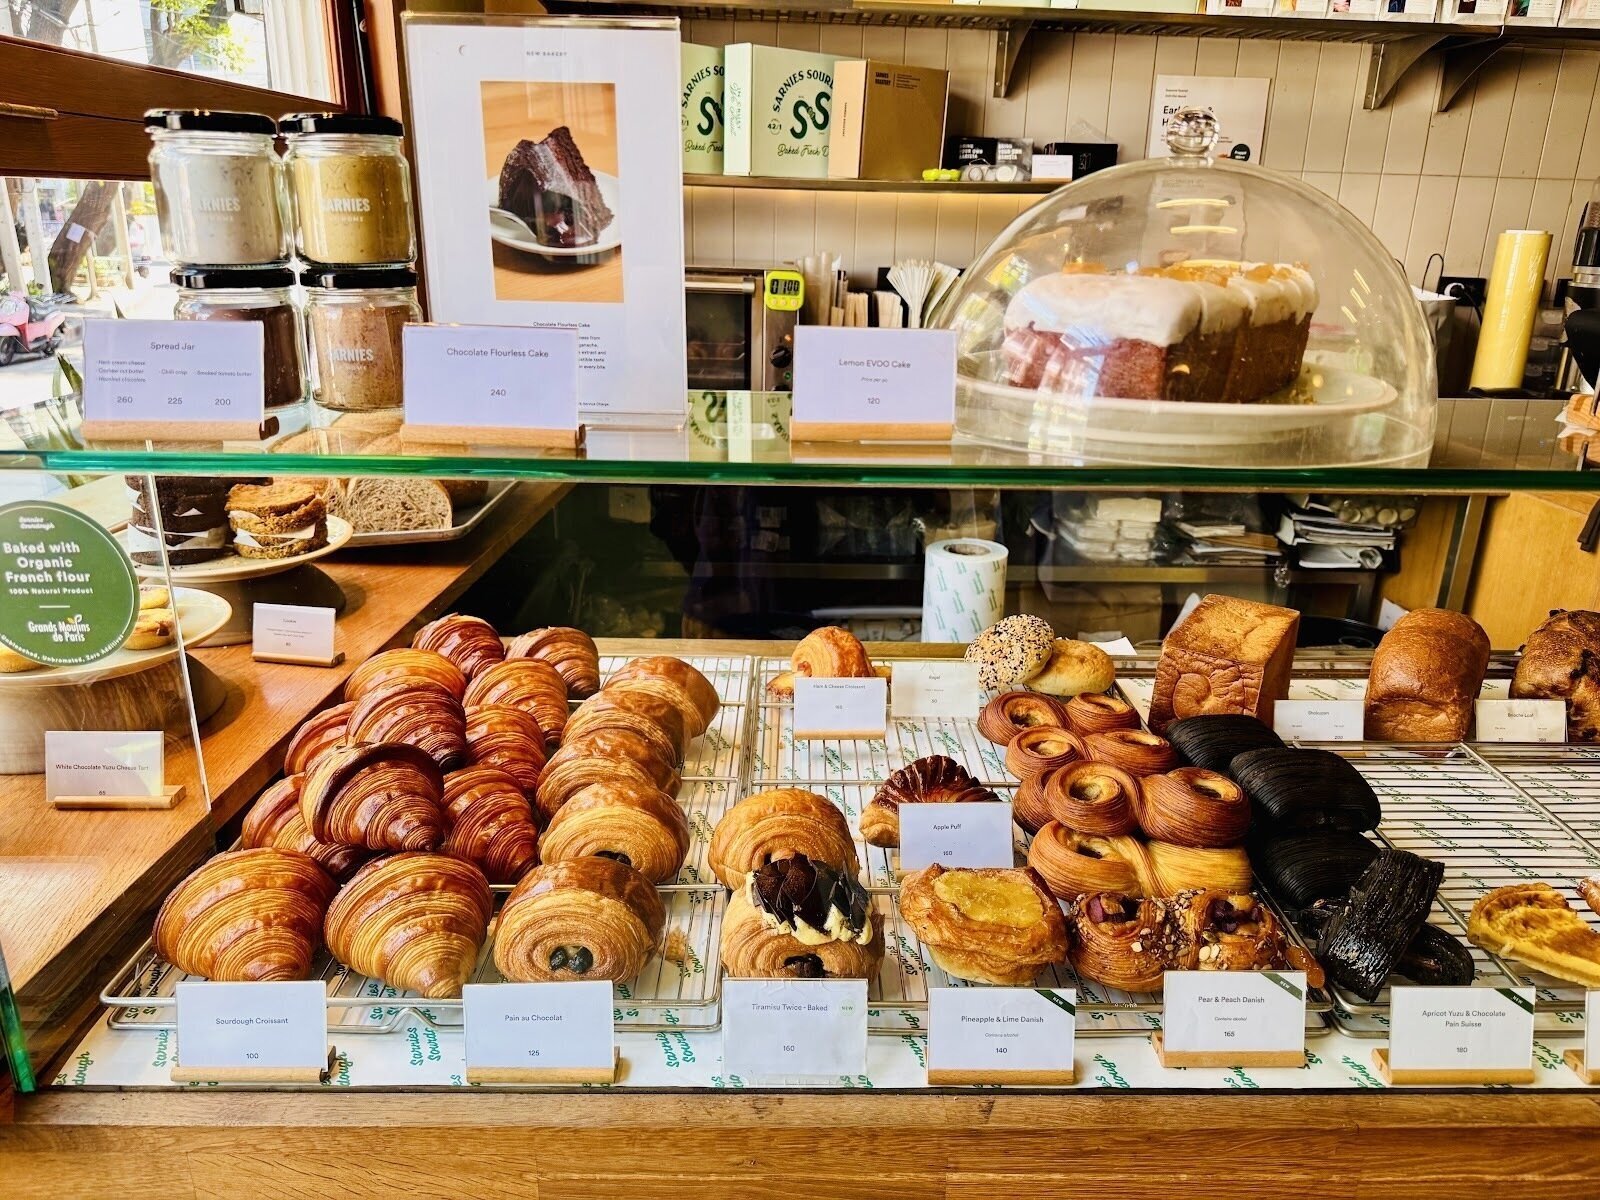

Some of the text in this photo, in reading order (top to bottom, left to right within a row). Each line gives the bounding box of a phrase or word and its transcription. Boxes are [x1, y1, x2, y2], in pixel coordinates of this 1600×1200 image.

[773, 70, 804, 112] SARNIES
[150, 342, 180, 350] Spread
[447, 348, 549, 358] Chocolate Flourless Cake
[866, 360, 890, 368] EVOO
[3, 542, 80, 553] Baked with
[16, 556, 73, 570] Organic
[5, 570, 91, 583] French flour
[28, 621, 57, 632] Grands
[53, 632, 85, 642] de Paris
[1279, 980, 1290, 989] NEW
[1512, 996, 1523, 1004] NEW
[1422, 1010, 1447, 1018] Apricot
[406, 1027, 424, 1066] Sarnies
[423, 1028, 441, 1062] Sourd
[655, 1032, 680, 1068] Sarnie
[671, 1032, 696, 1063] Sourd
